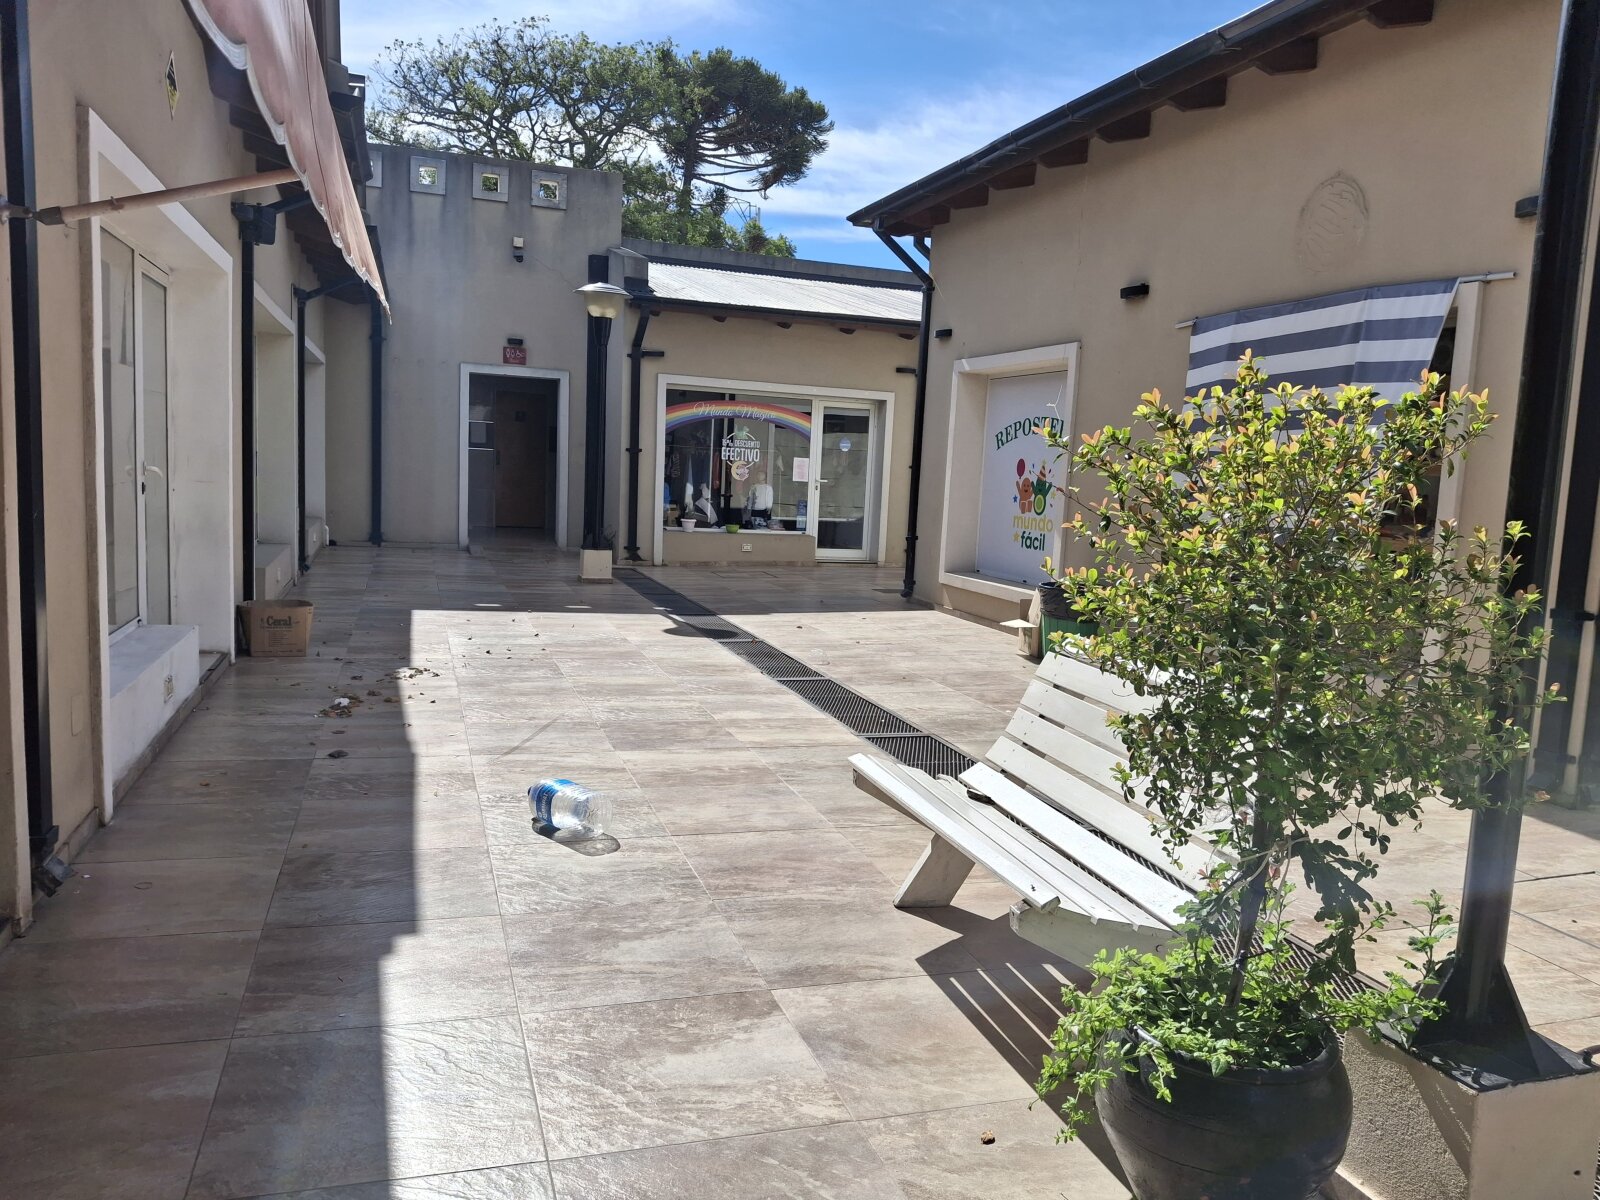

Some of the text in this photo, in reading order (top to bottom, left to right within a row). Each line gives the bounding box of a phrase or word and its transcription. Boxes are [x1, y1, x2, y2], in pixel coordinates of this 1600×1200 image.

[693, 402, 733, 416] Mundo
[734, 440, 760, 448] DESCUENTO
[721, 447, 760, 462] EFECTIVO
[1013, 515, 1053, 533] mundo
[1020, 531, 1046, 551] fácil
